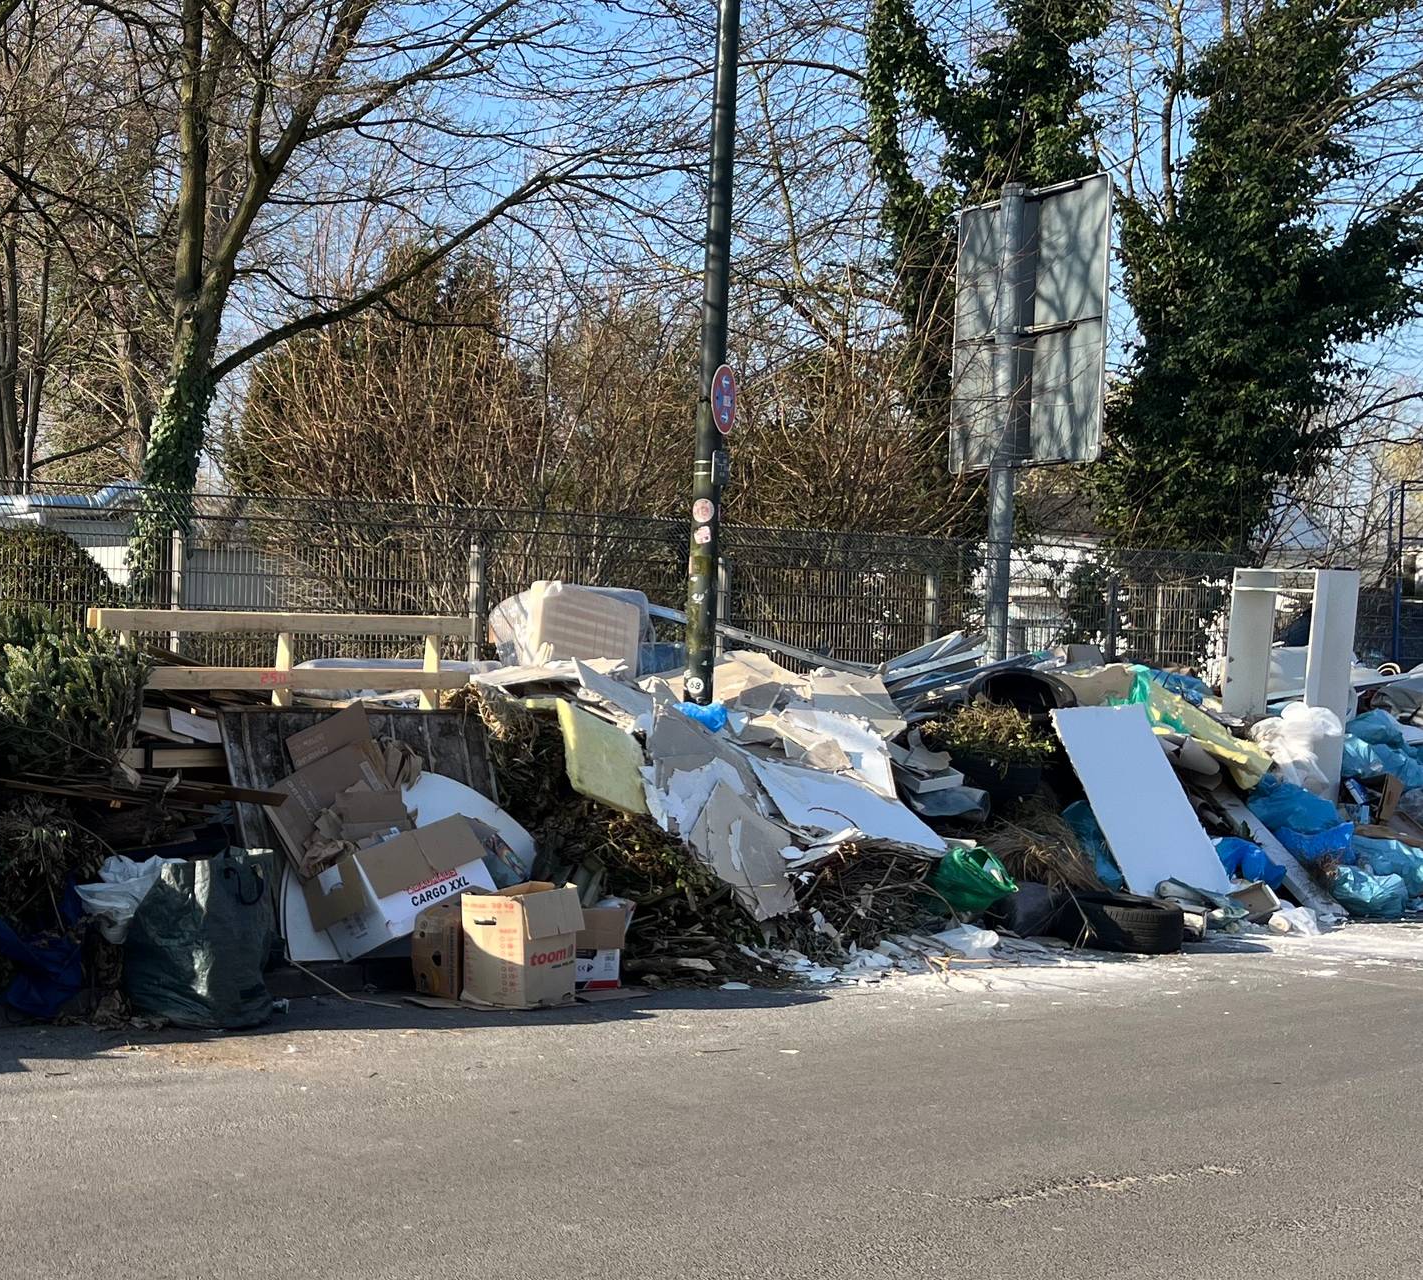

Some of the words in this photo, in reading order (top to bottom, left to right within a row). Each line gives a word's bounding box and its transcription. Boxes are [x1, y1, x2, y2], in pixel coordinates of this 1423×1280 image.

[411, 884, 448, 907] CARGO
[449, 876, 470, 892] XXL
[530, 950, 566, 967] toom
